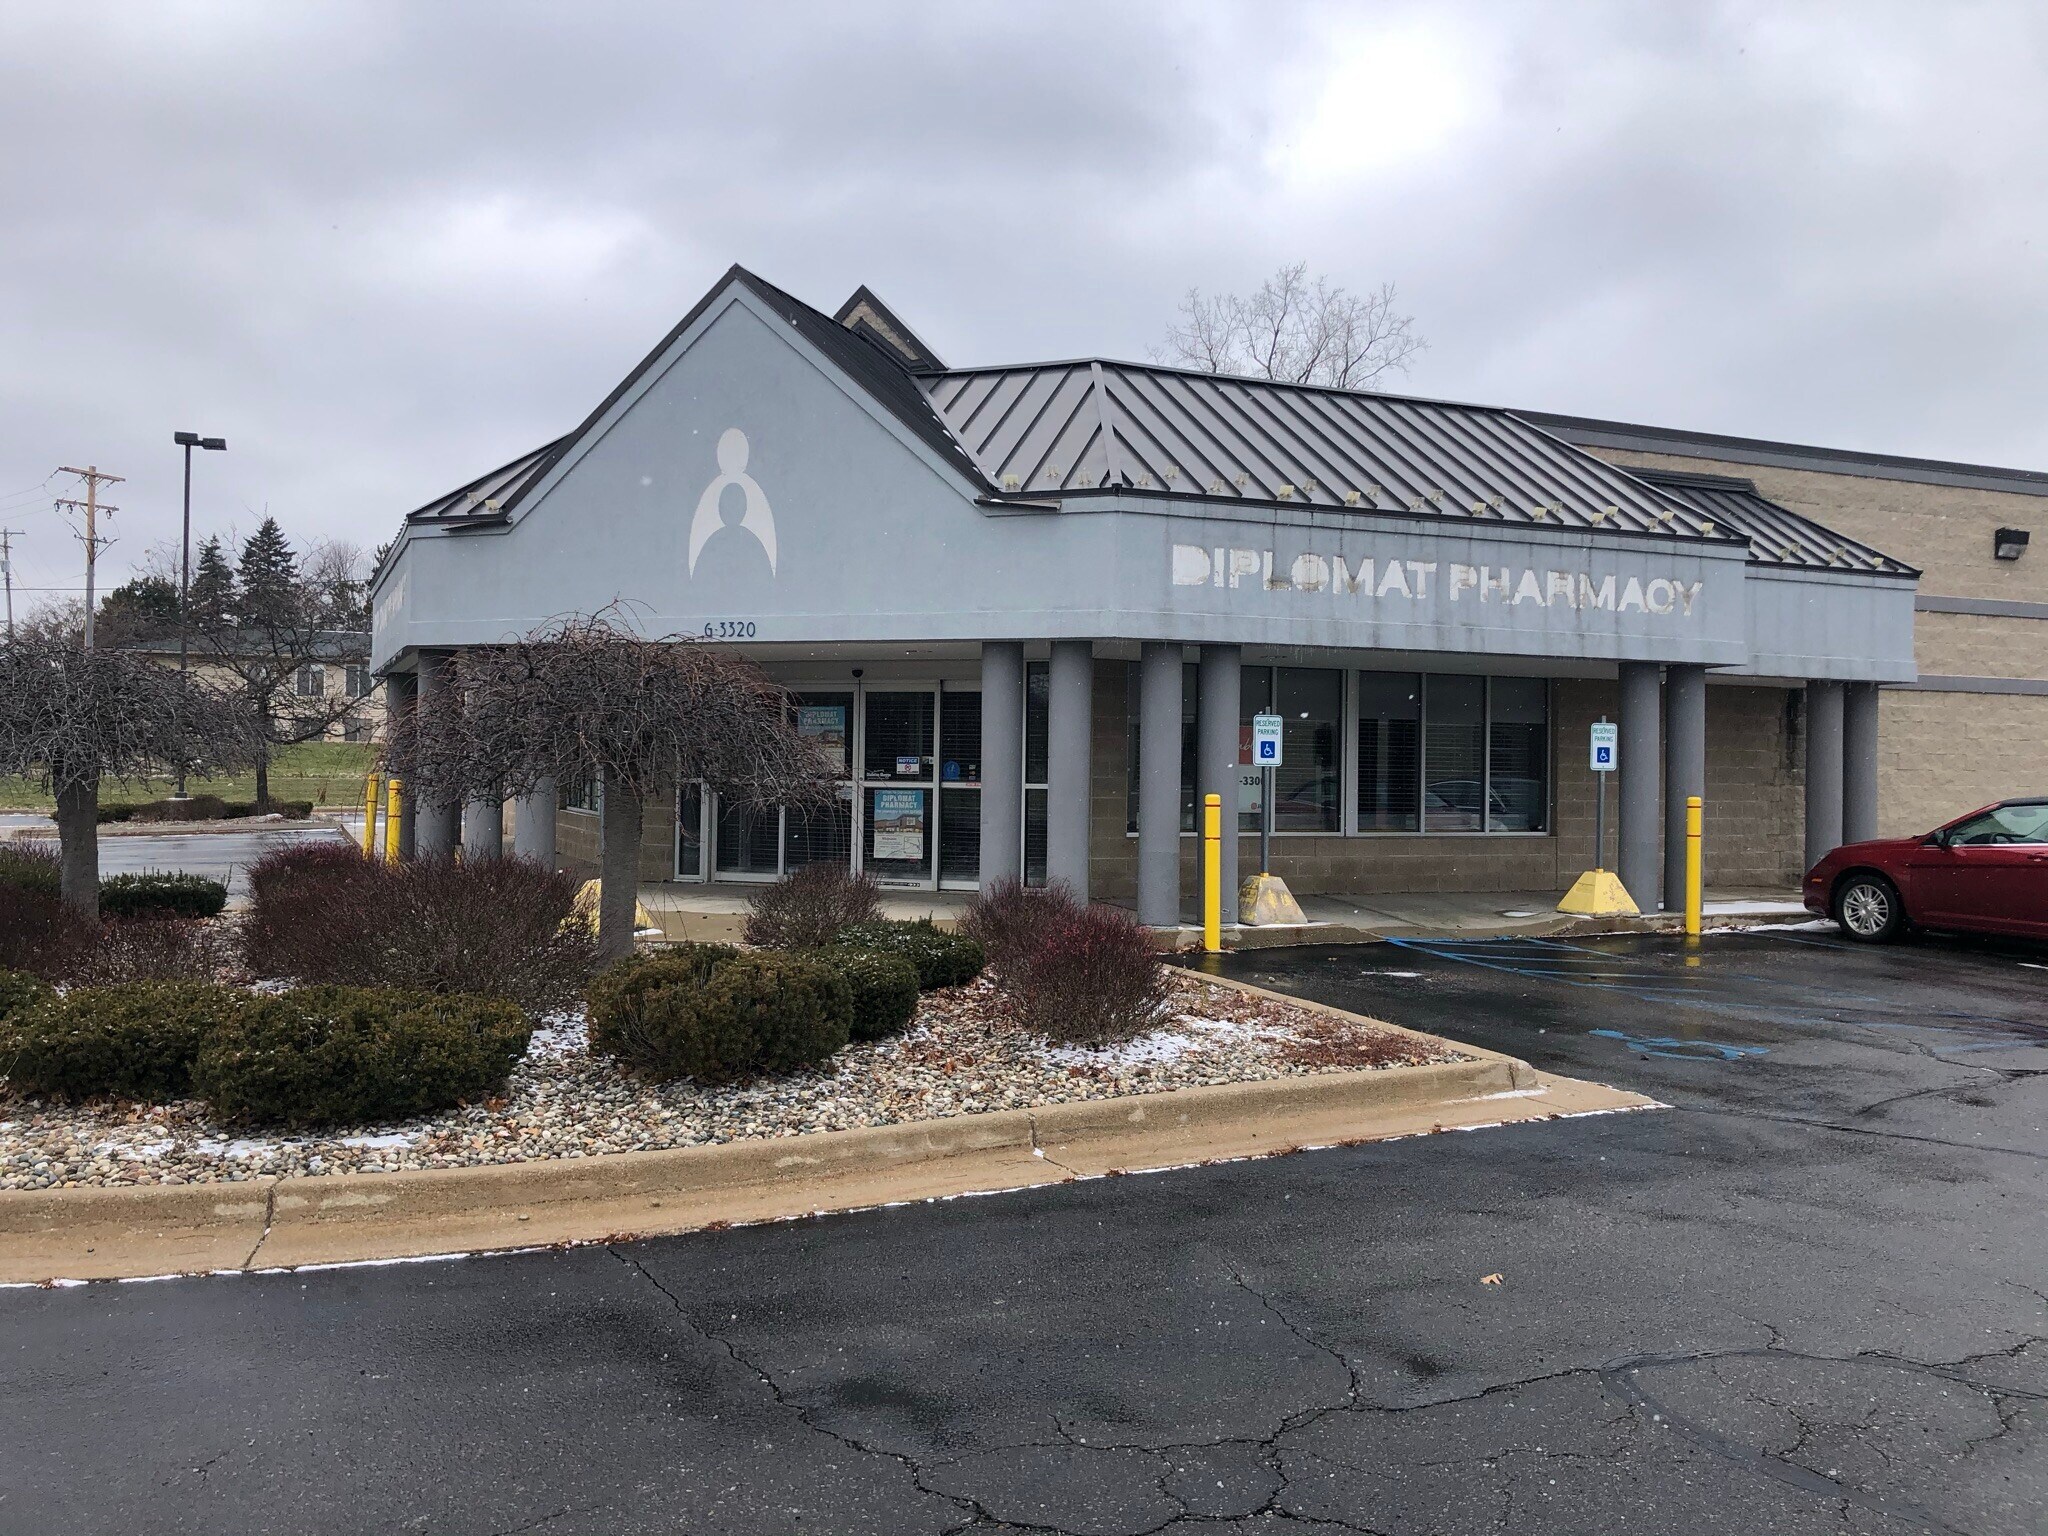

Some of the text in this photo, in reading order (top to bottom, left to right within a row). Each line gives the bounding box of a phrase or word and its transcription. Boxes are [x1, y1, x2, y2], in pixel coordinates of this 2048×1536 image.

[1172, 544, 1703, 617] DIPLOMAT PHARMACY
[704, 621, 756, 638] G-3320
[1256, 719, 1280, 727] RESERVED
[1257, 728, 1279, 736] PARKING
[1592, 727, 1615, 735] RESERVED
[882, 794, 916, 802] DIPLOMAT
[880, 801, 918, 809] PHARMACY
